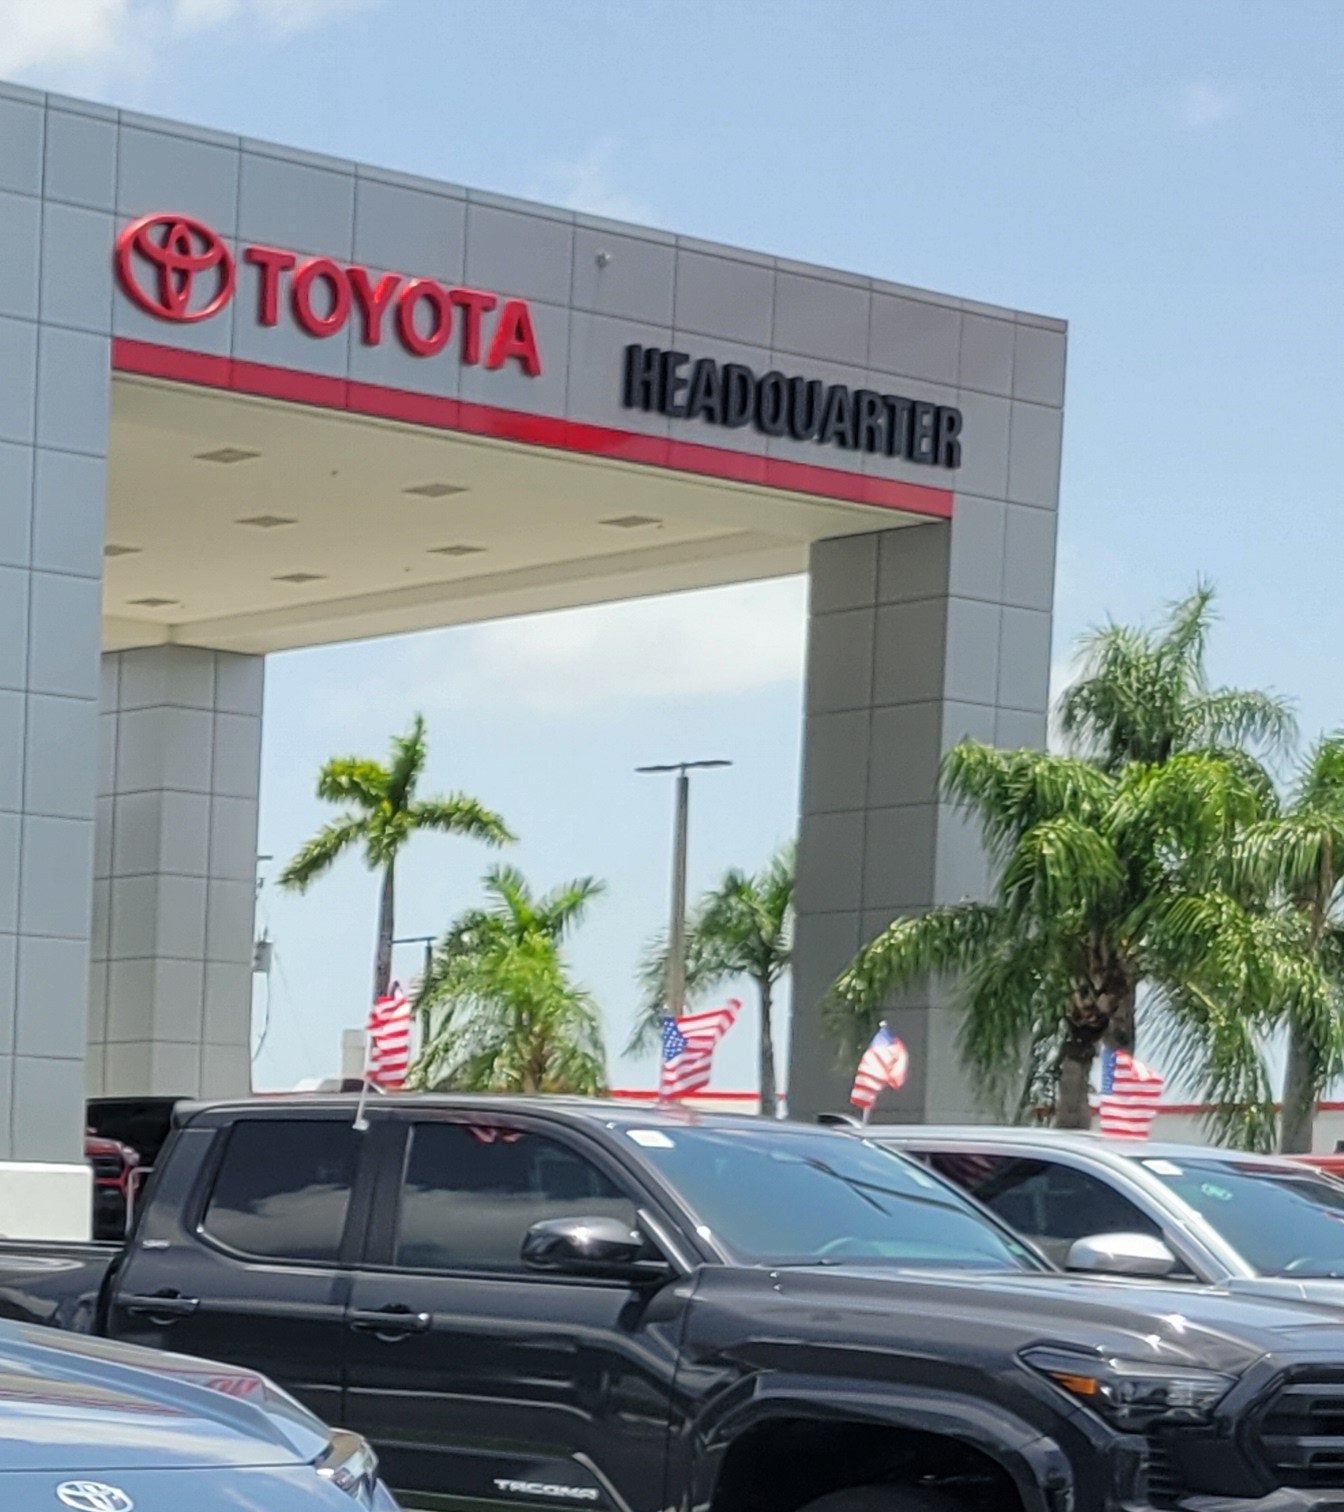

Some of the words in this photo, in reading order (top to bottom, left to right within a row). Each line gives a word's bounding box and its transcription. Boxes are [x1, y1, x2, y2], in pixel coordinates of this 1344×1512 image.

[246, 245, 542, 376] TOYOTA
[621, 343, 964, 470] HEADQUARTER
[493, 1478, 599, 1500] TACOMA
